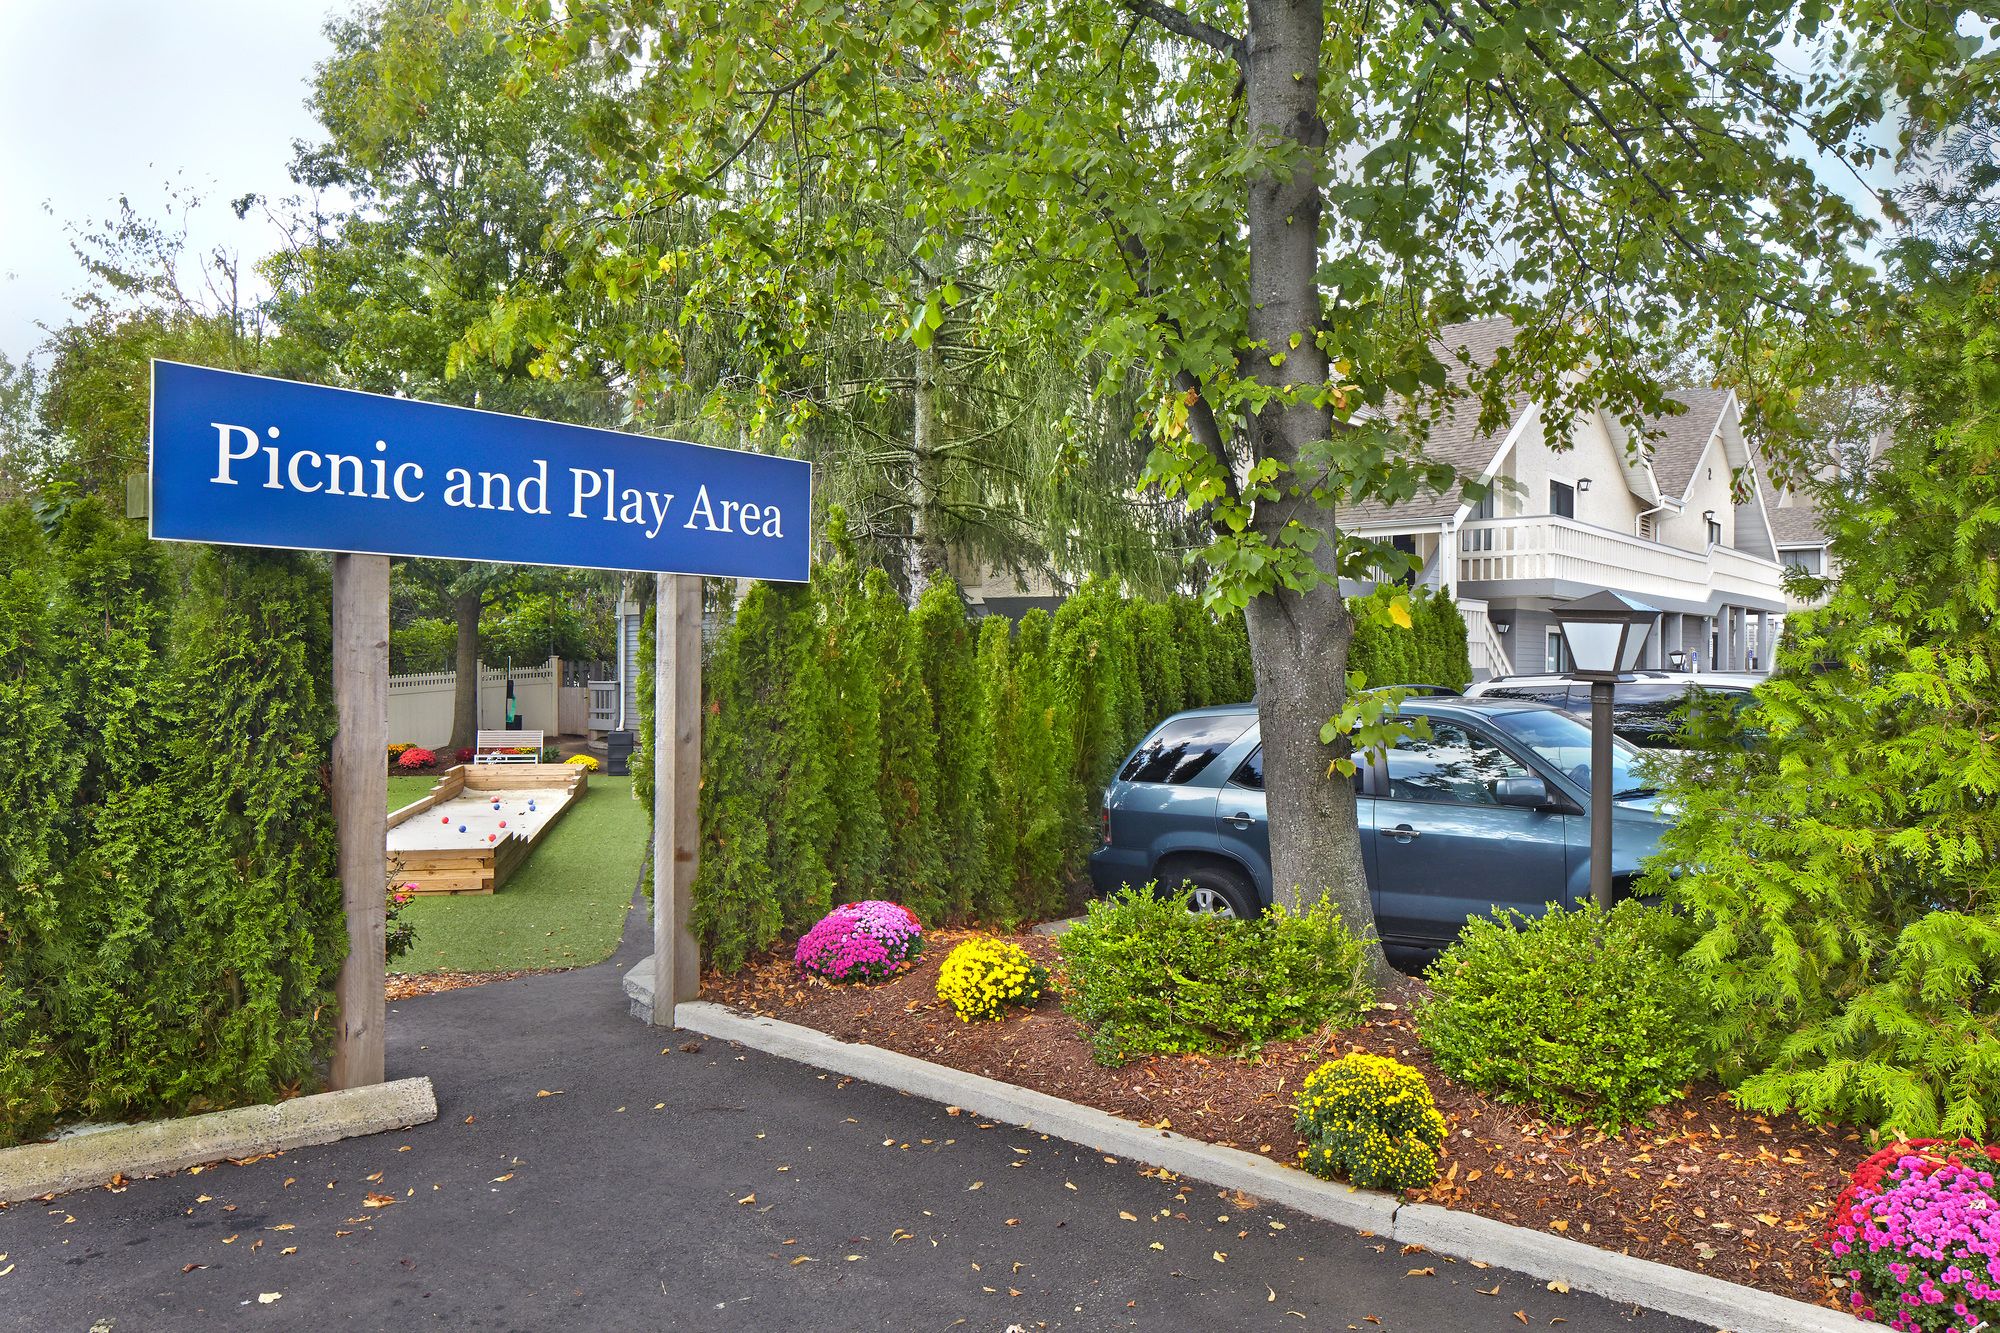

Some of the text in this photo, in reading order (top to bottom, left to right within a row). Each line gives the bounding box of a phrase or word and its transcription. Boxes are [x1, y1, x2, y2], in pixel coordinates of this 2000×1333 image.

[209, 422, 784, 540] Picnic and Play Area
